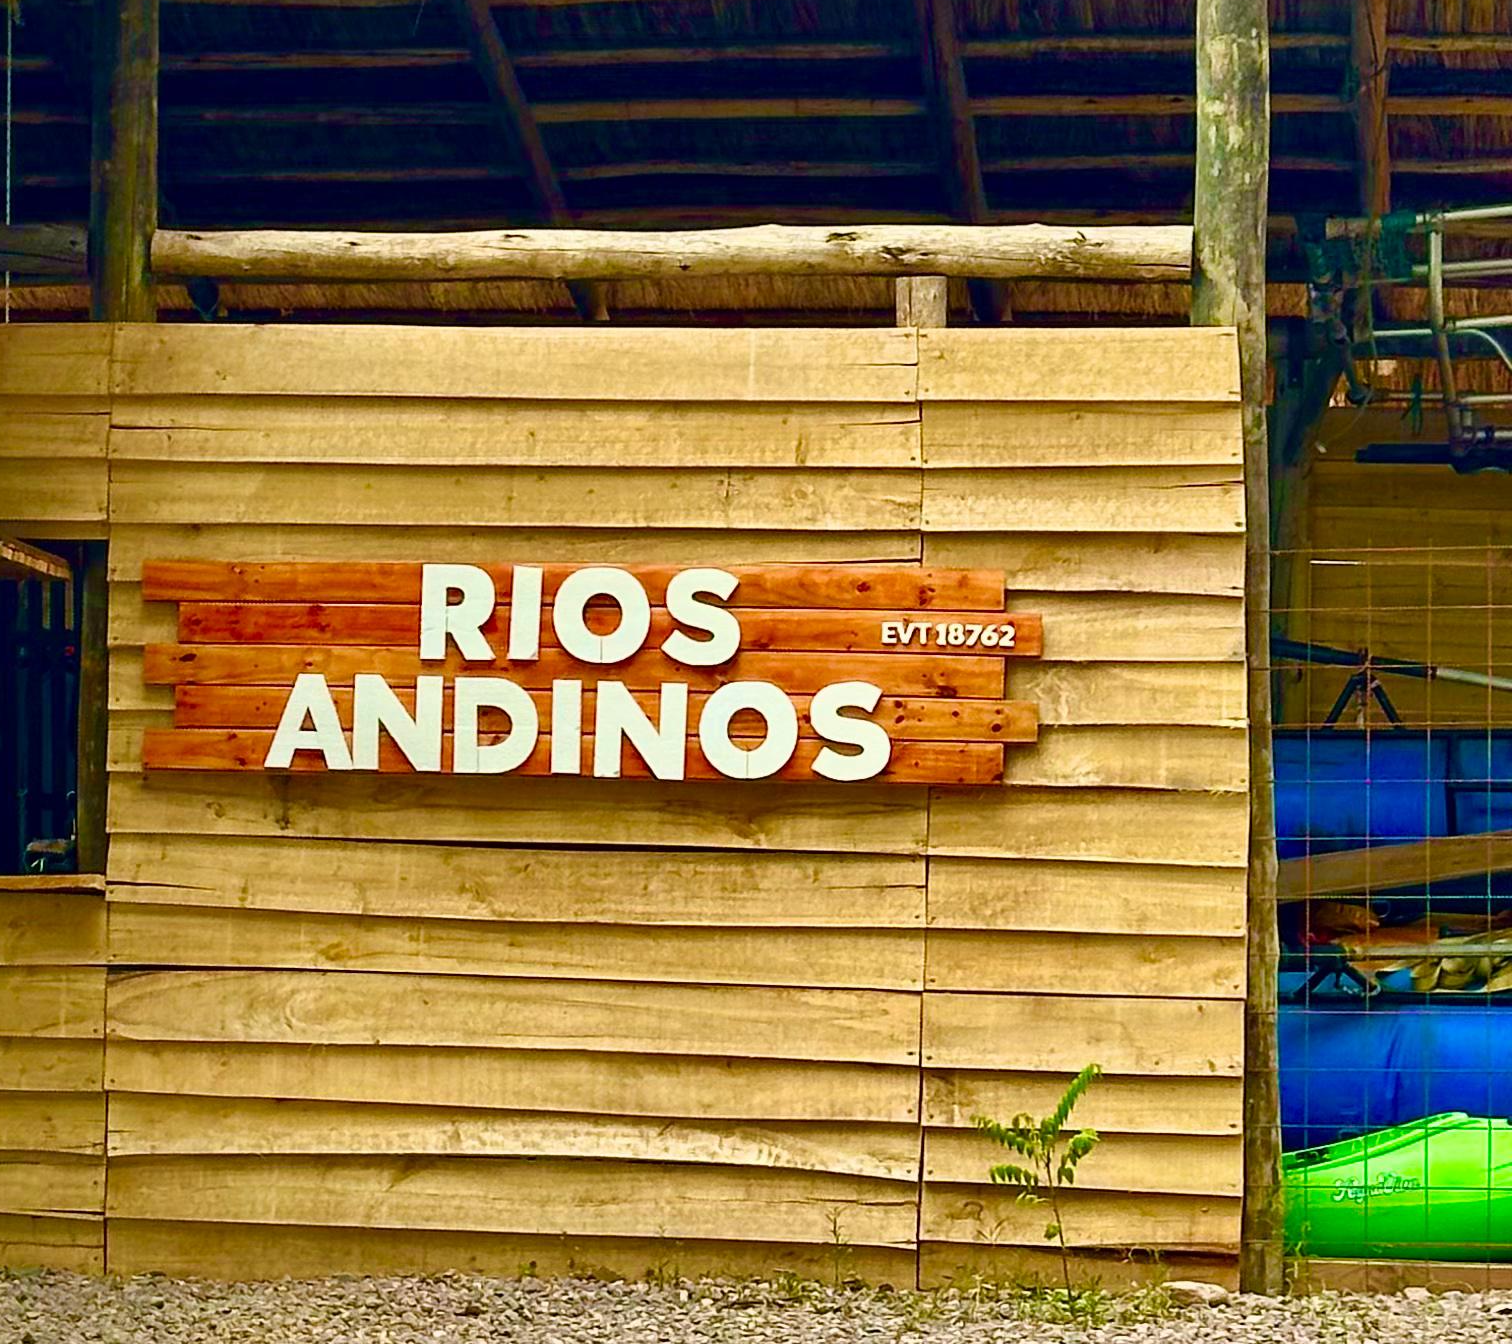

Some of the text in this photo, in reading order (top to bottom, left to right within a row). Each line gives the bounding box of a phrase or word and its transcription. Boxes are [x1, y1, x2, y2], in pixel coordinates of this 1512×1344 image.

[419, 563, 741, 666] RIOS
[881, 621, 1016, 647] EVT 18762
[264, 673, 891, 782] ANDINOS
